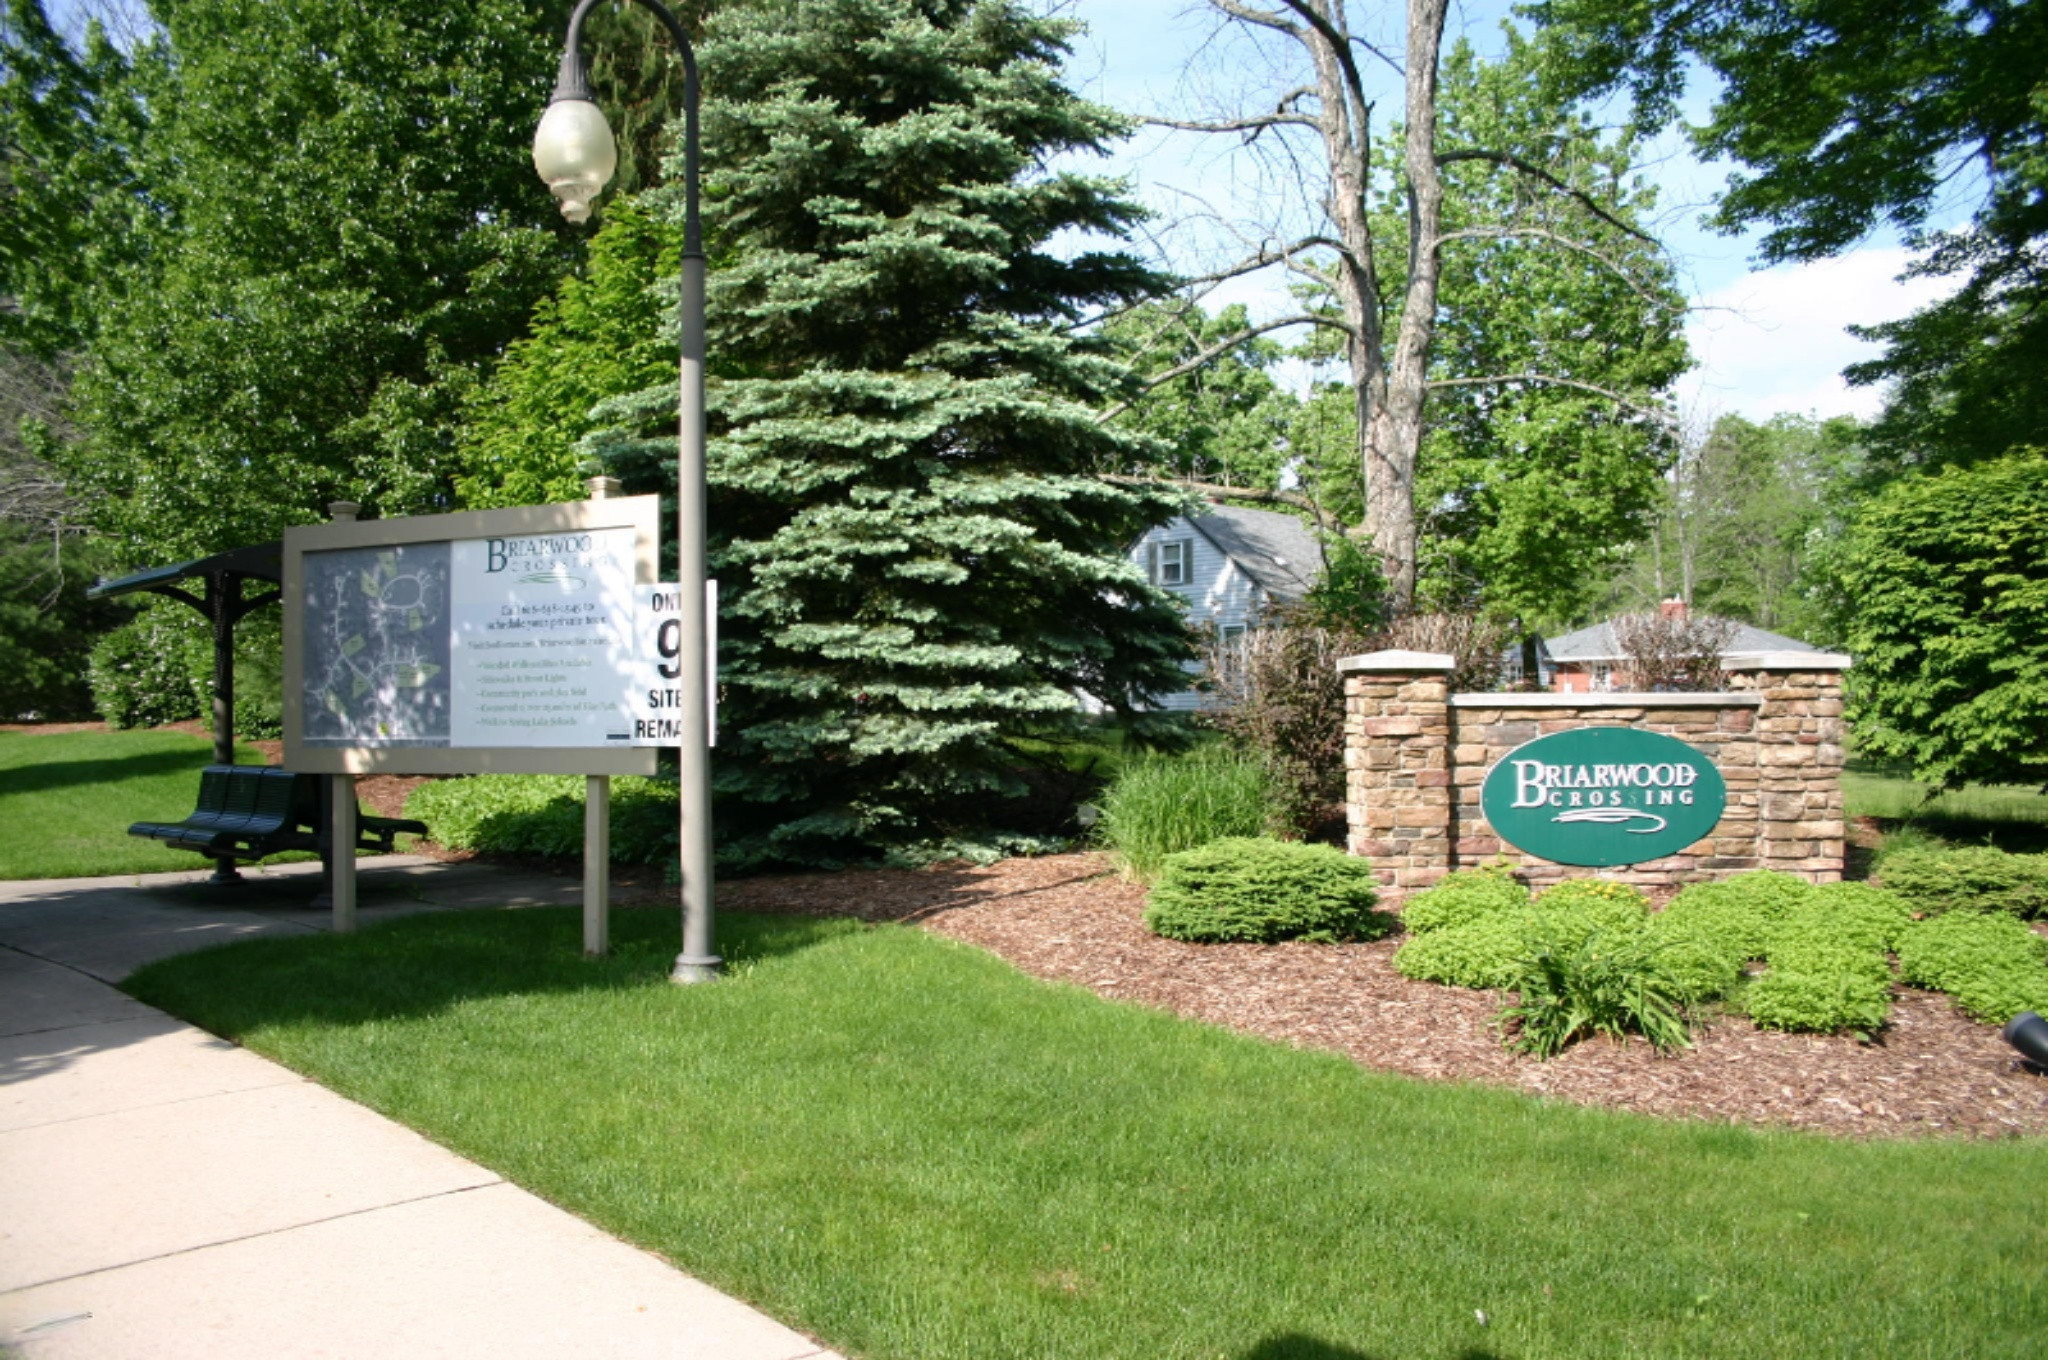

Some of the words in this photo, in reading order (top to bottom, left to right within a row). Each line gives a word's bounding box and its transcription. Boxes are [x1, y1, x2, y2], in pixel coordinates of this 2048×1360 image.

[657, 617, 682, 679] 9
[648, 689, 682, 709] SITE
[634, 718, 682, 739] REMA
[1510, 759, 1698, 808] BRIARWOOD
